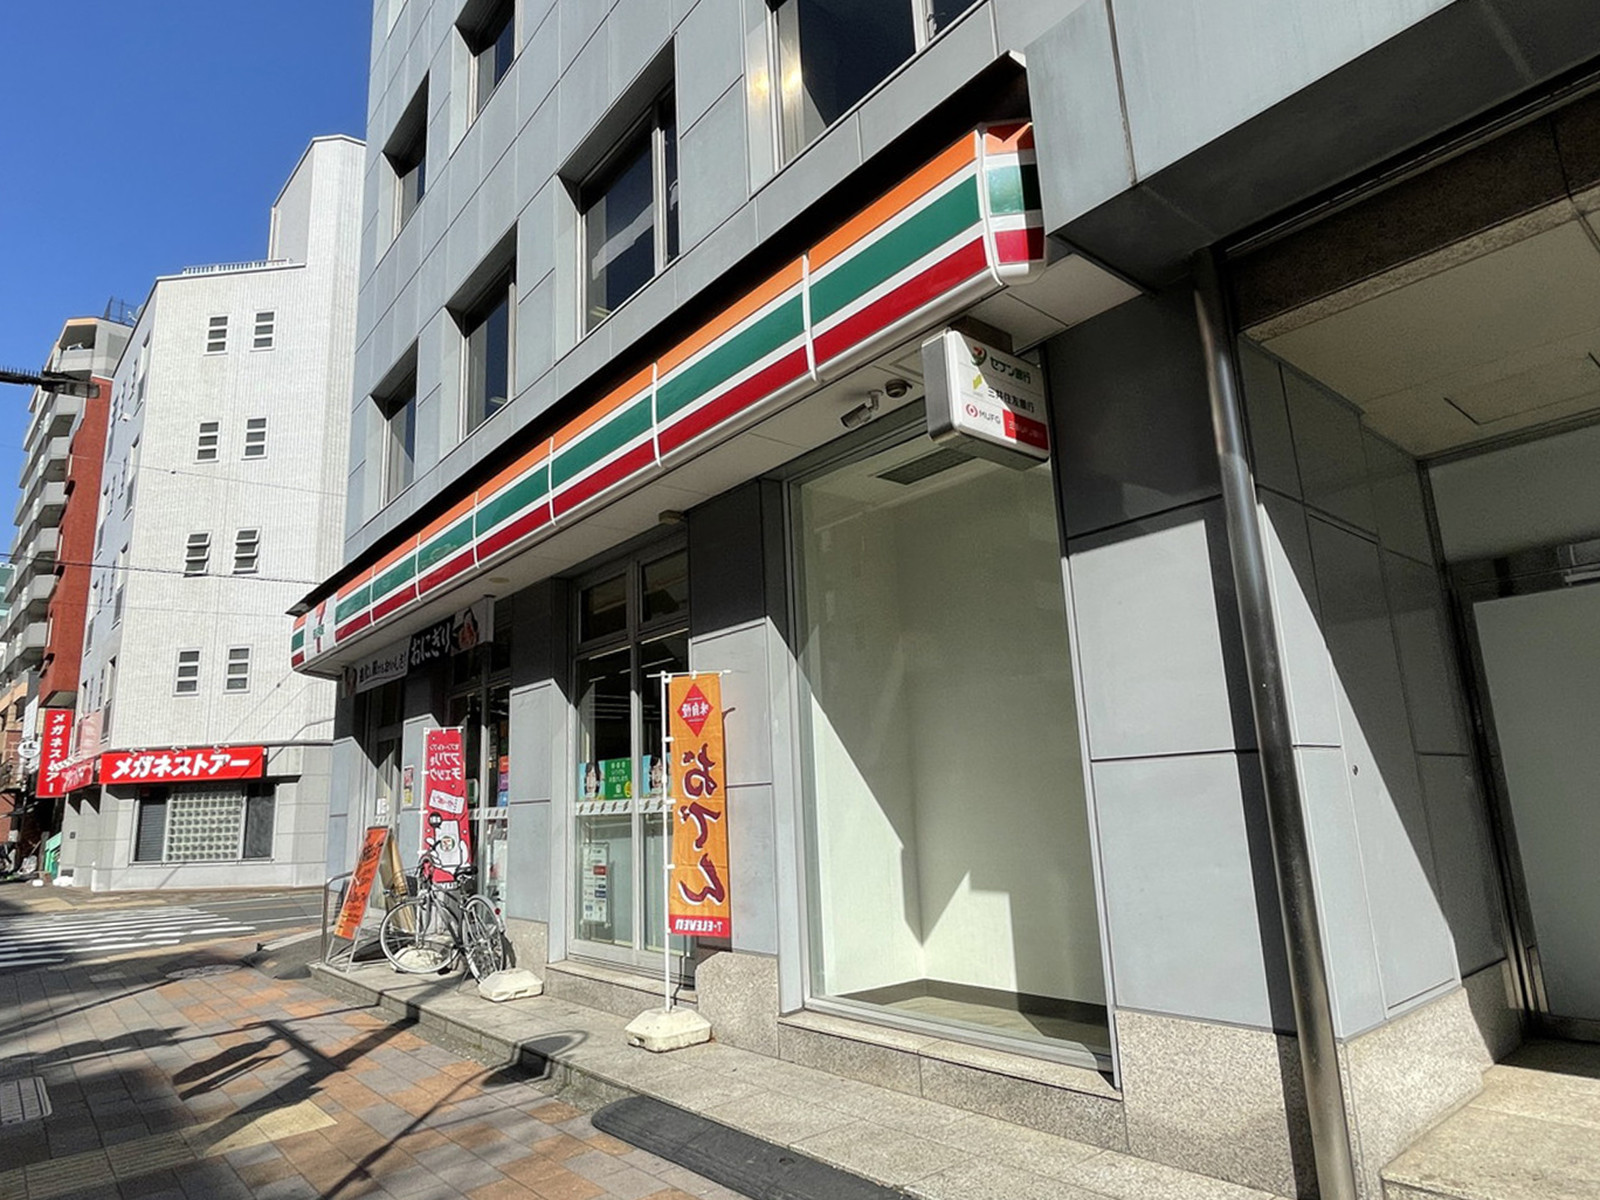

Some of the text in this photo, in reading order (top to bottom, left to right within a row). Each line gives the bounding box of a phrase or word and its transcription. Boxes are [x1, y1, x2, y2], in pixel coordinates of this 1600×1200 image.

[410, 622, 451, 666] おにぎり
[45, 713, 66, 793] メガネストアー
[112, 752, 250, 780] メガネストアー
